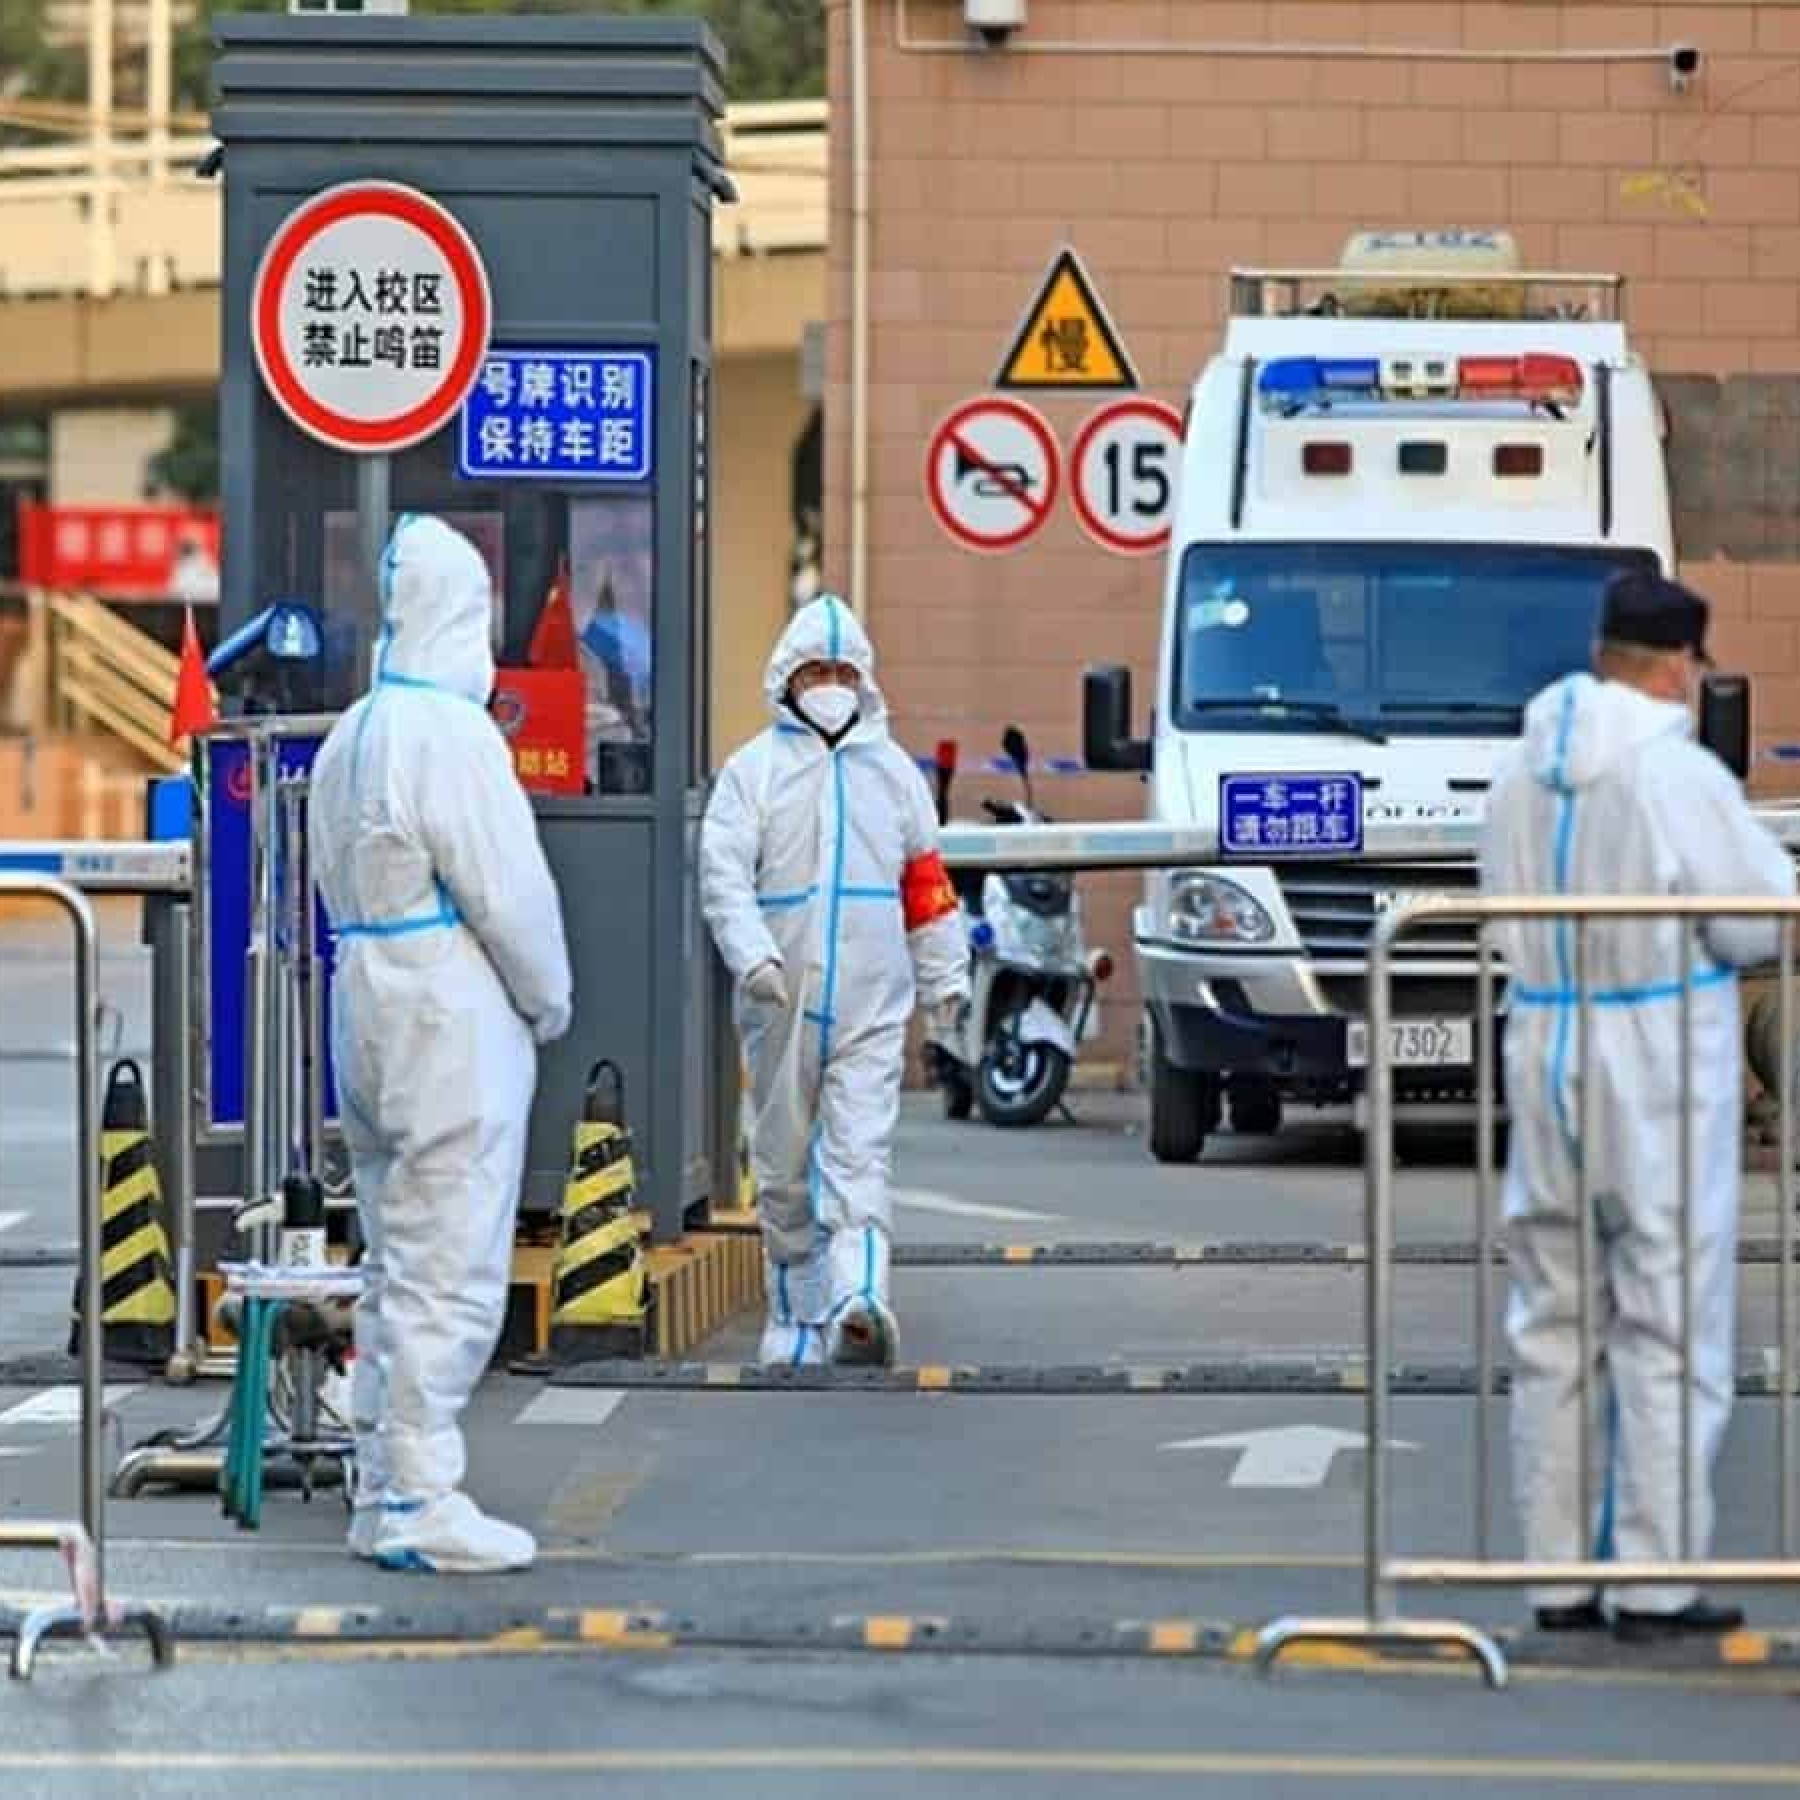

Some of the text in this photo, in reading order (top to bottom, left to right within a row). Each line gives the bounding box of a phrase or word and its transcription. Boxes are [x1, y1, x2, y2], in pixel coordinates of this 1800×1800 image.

[304, 269, 443, 316] 进入校区
[303, 322, 444, 370] 禁止鸣笛
[1041, 317, 1089, 373] 慢
[482, 361, 635, 411] 号牌识别
[479, 416, 636, 466] 保持车距
[1104, 441, 1170, 517] 15
[1233, 782, 1348, 812] 一车一杆
[1391, 1026, 1453, 1058] 7302
